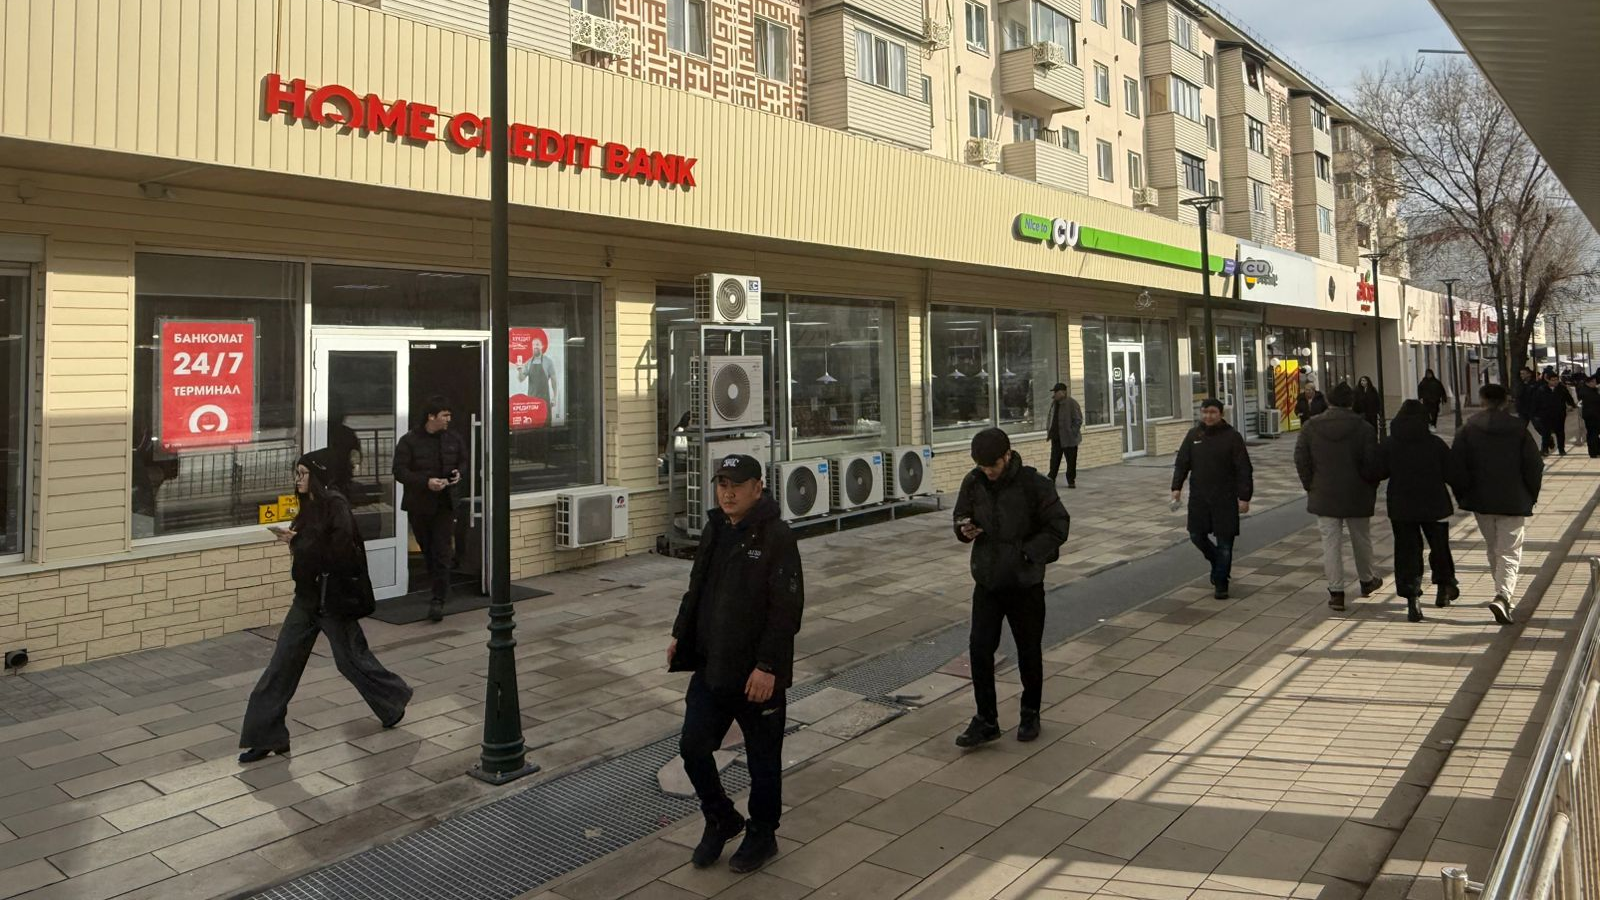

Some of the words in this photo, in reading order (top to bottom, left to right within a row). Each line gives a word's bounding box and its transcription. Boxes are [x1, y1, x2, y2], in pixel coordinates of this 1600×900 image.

[267, 74, 437, 141] HOME
[605, 142, 698, 187] BANK
[1053, 218, 1079, 247] CU
[1246, 264, 1266, 273] CU
[174, 333, 244, 343] БАНКОМАТ
[173, 351, 244, 377] 24/7
[173, 385, 241, 396] ТЕРМИНАЛ
